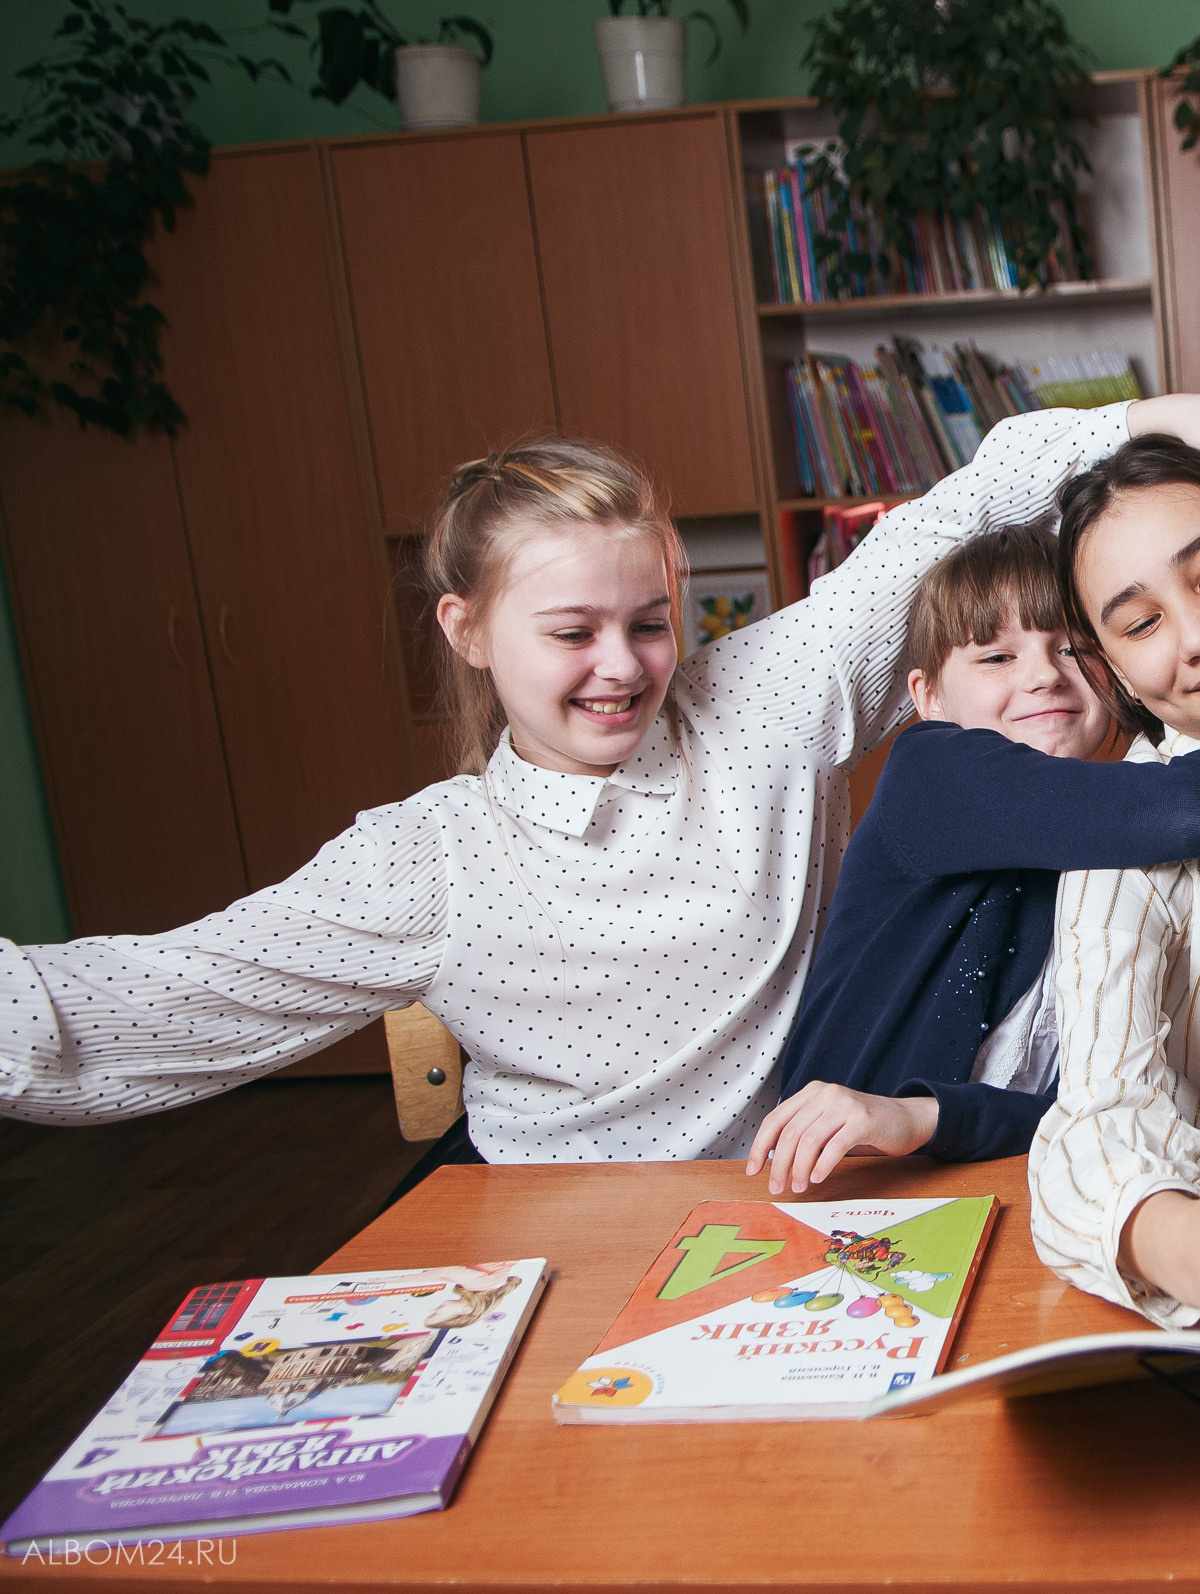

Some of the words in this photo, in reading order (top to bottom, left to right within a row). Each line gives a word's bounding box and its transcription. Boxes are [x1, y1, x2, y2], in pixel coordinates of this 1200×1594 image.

[830, 1210, 841, 1218] 2
[846, 1209, 895, 1218] Часть
[655, 1224, 787, 1300] 4
[735, 1336, 926, 1361] Русский
[72, 1448, 120, 1470] 4
[195, 1433, 339, 1465] ЯЗЫК
[91, 1438, 413, 1494] АНГЛИЙСКИЙ
